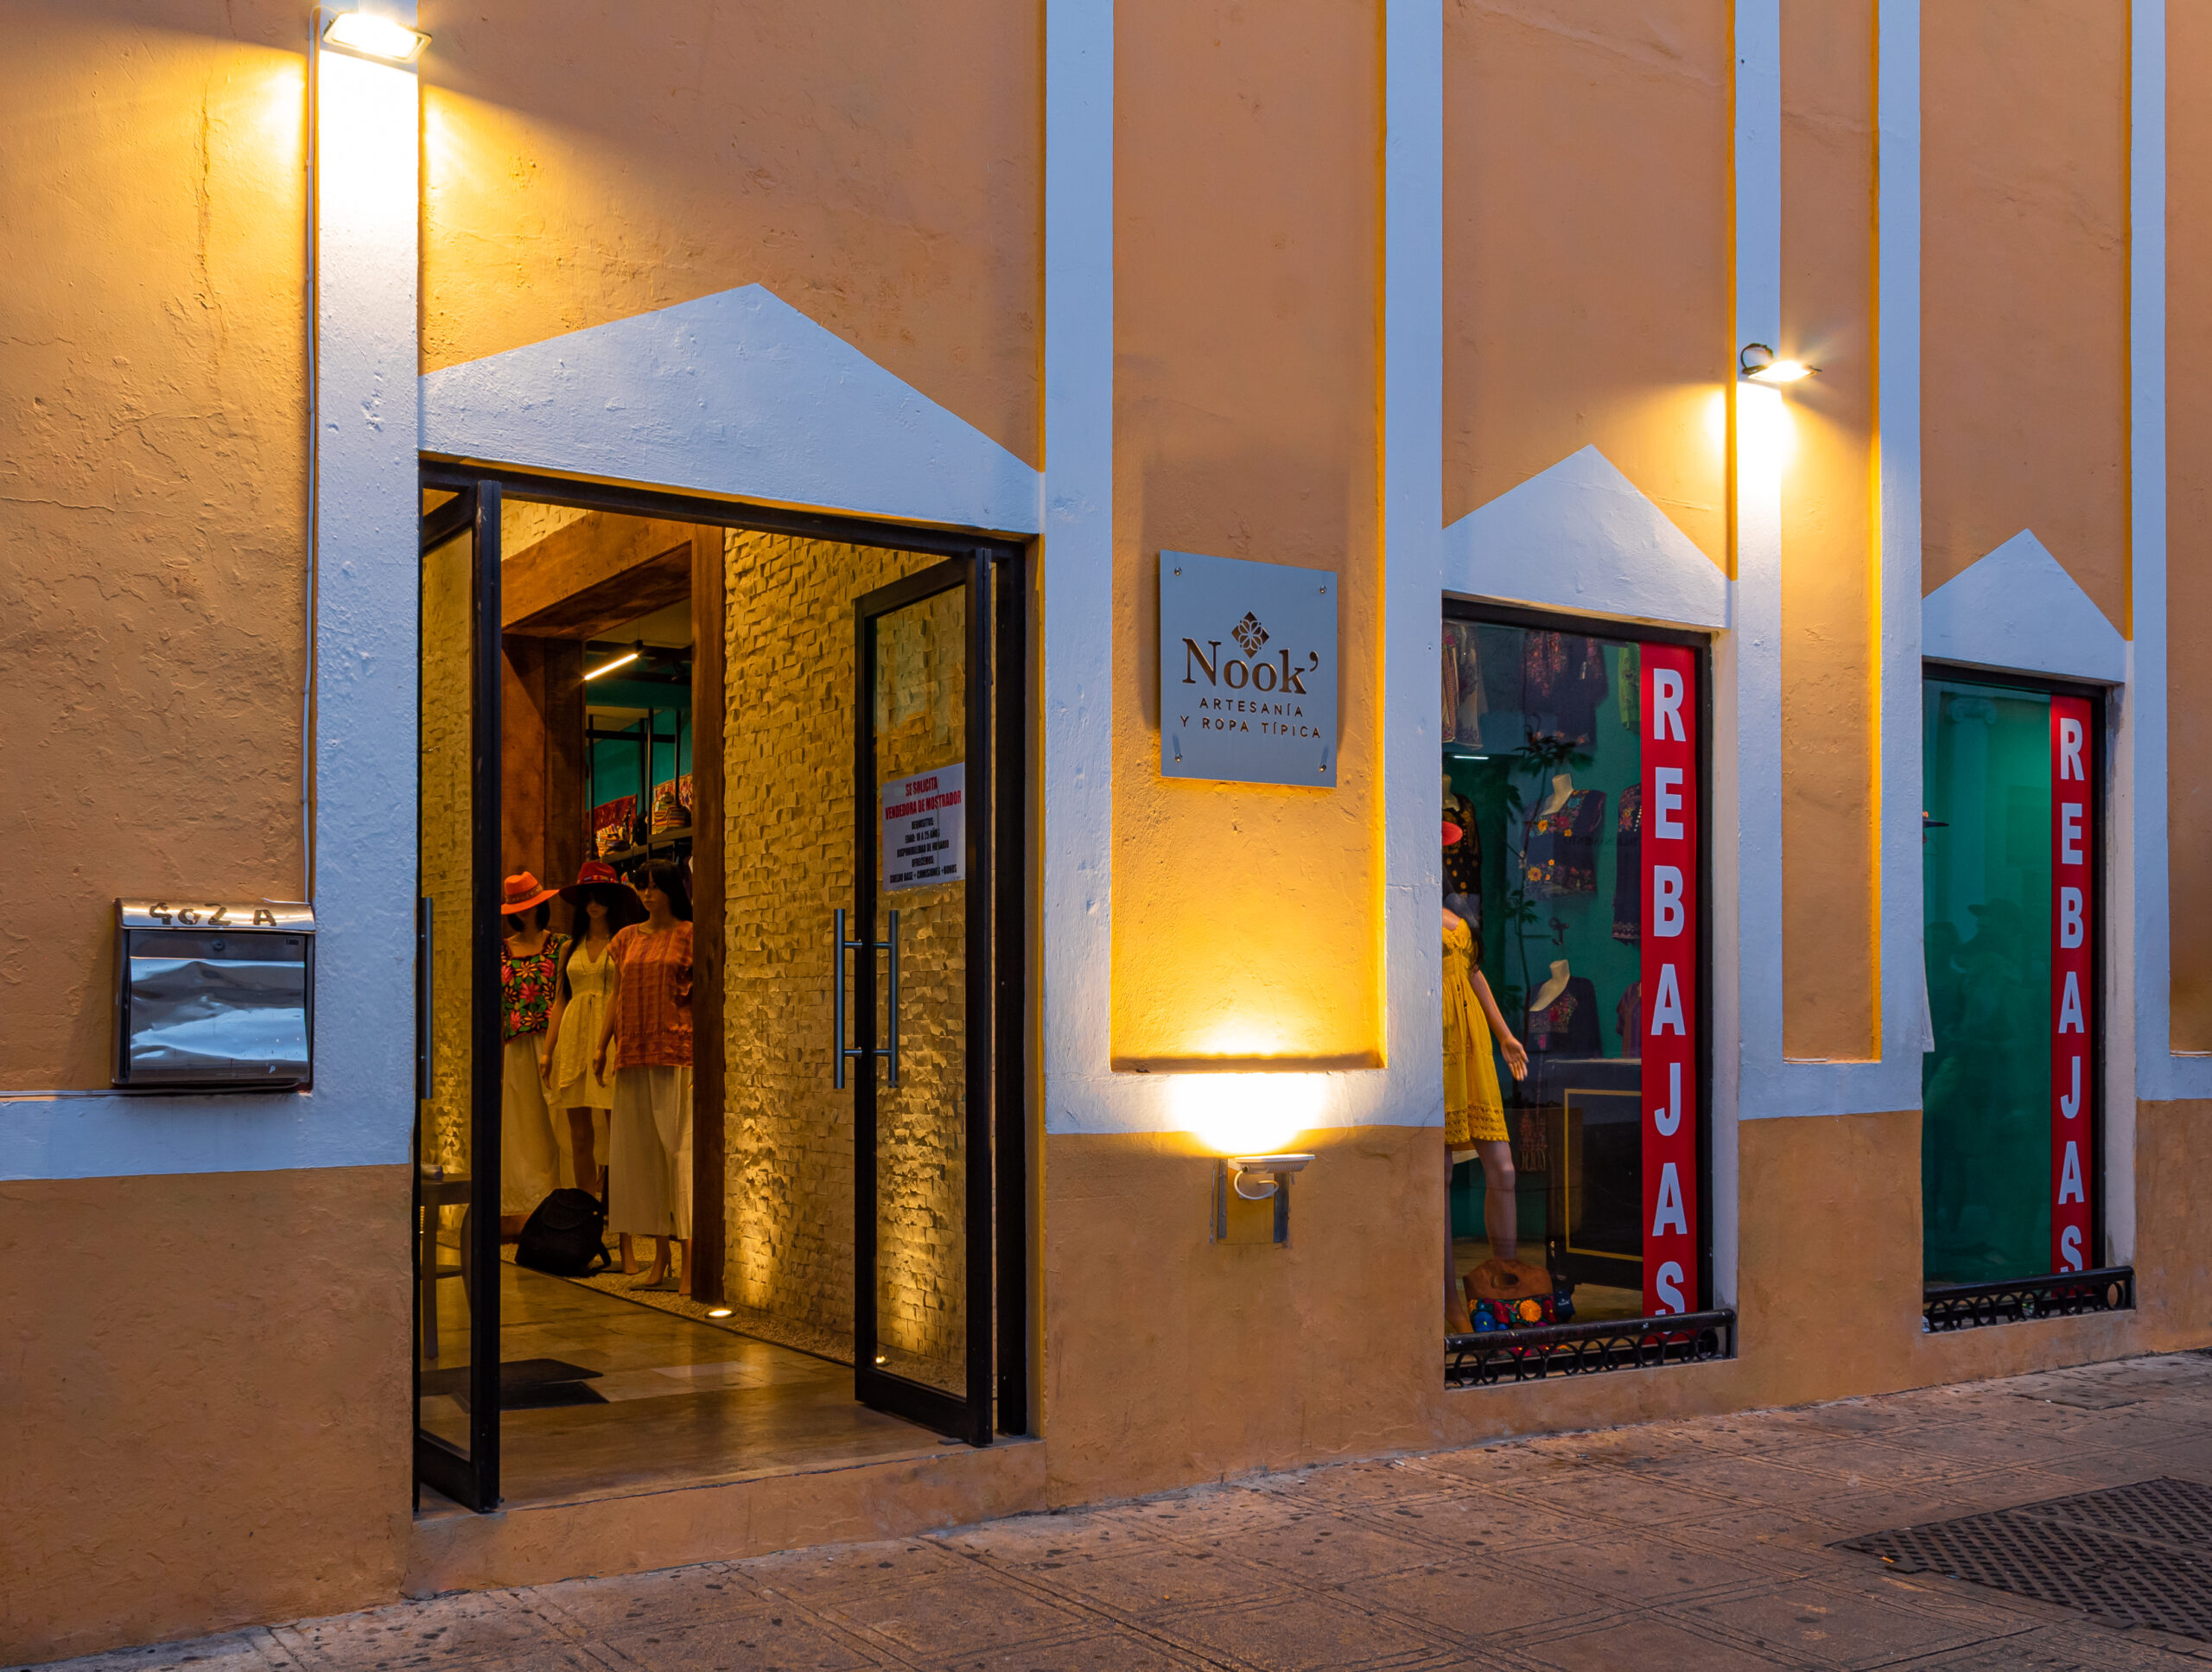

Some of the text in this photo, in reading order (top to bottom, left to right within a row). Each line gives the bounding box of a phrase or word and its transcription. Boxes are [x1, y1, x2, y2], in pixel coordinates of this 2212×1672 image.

[1182, 637, 1319, 695] Nook'
[1199, 697, 1303, 717] ARTESANÍA
[1180, 715, 1320, 739] Y ROPA TÍPICA
[905, 776, 938, 797] SE SOLICITA
[885, 790, 961, 820] VENDEDORA DE MOSTRADOR
[253, 909, 276, 926] A
[1650, 668, 1688, 1334] REBAJAS
[2057, 718, 2085, 1274] REBAJAS
